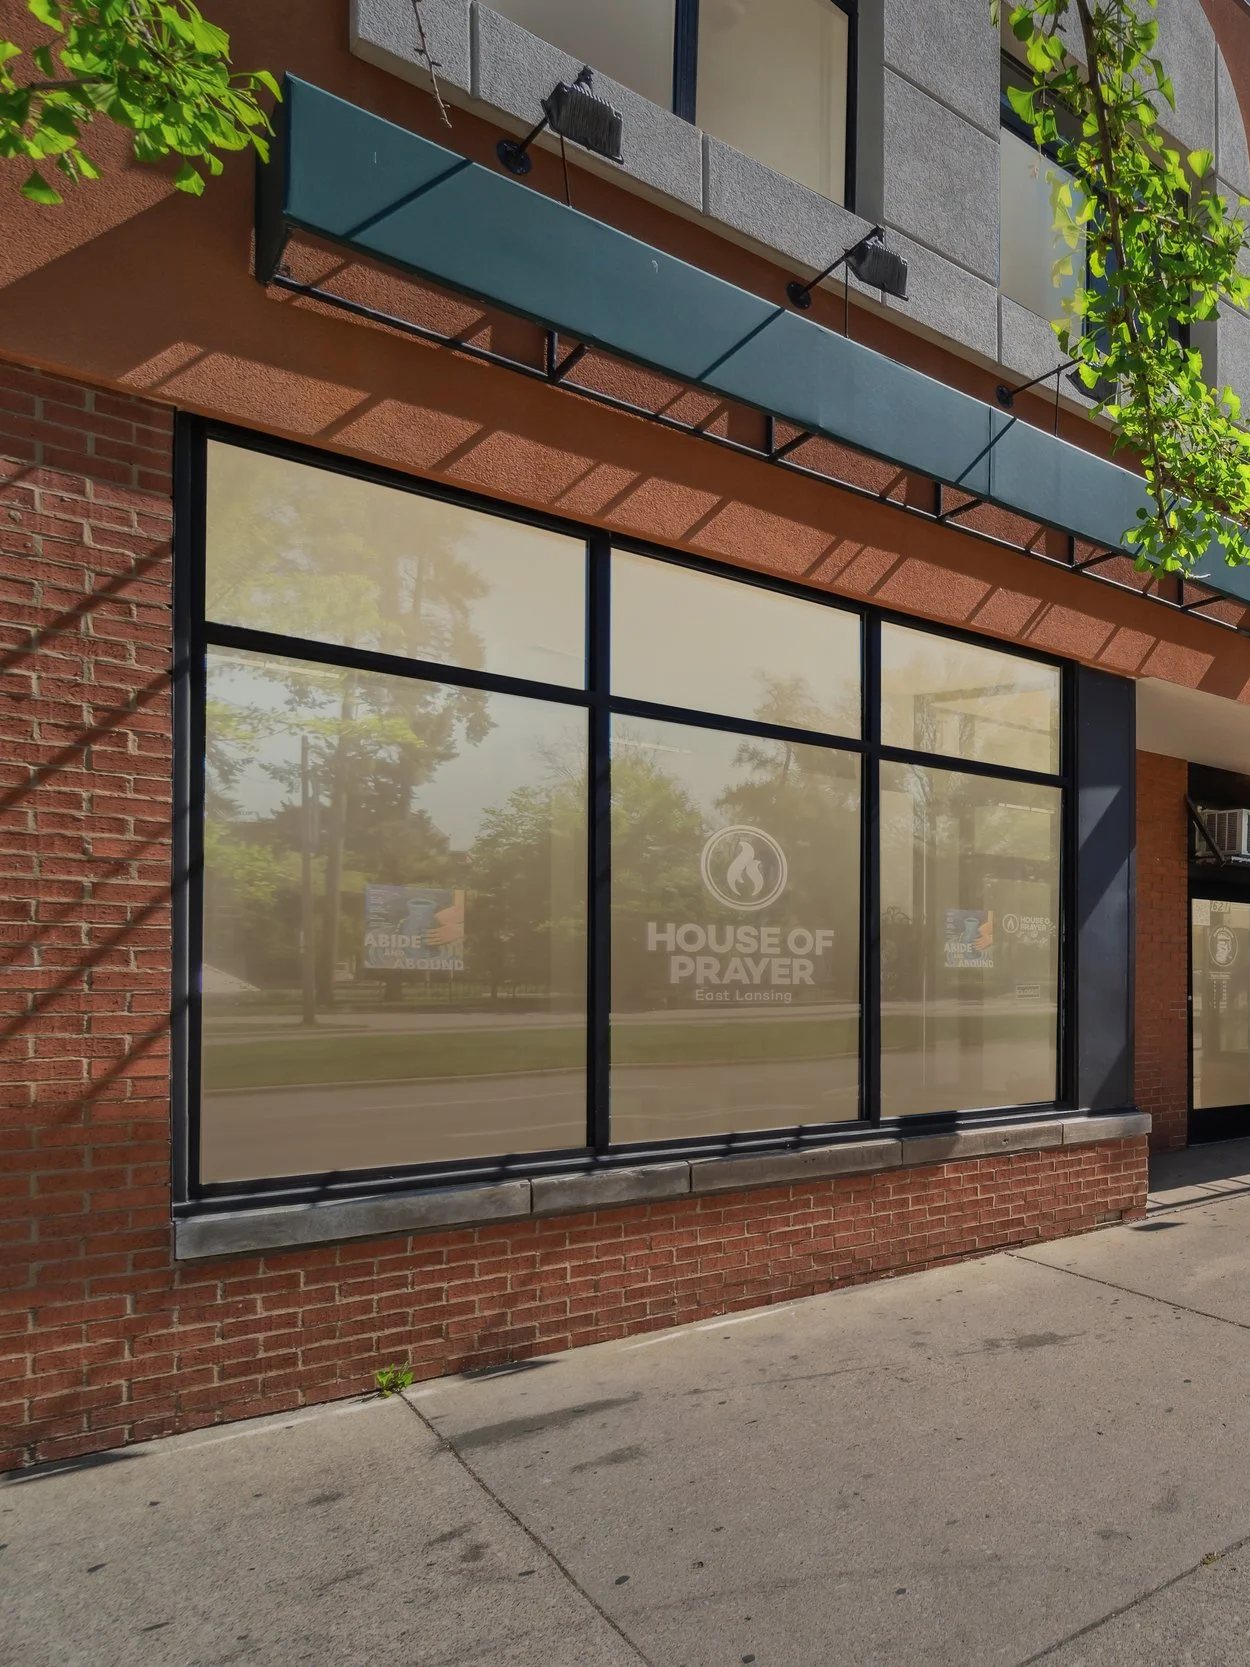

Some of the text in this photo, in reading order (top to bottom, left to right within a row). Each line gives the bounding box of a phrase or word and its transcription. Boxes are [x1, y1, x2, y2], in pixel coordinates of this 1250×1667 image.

[364, 931, 422, 949] ABIDE
[647, 922, 835, 956] HOUSE OF
[944, 942, 973, 953] ABIDE
[395, 958, 465, 970] ABOUND
[670, 955, 815, 985] PRAYER
[695, 989, 792, 1004] East Lansing
